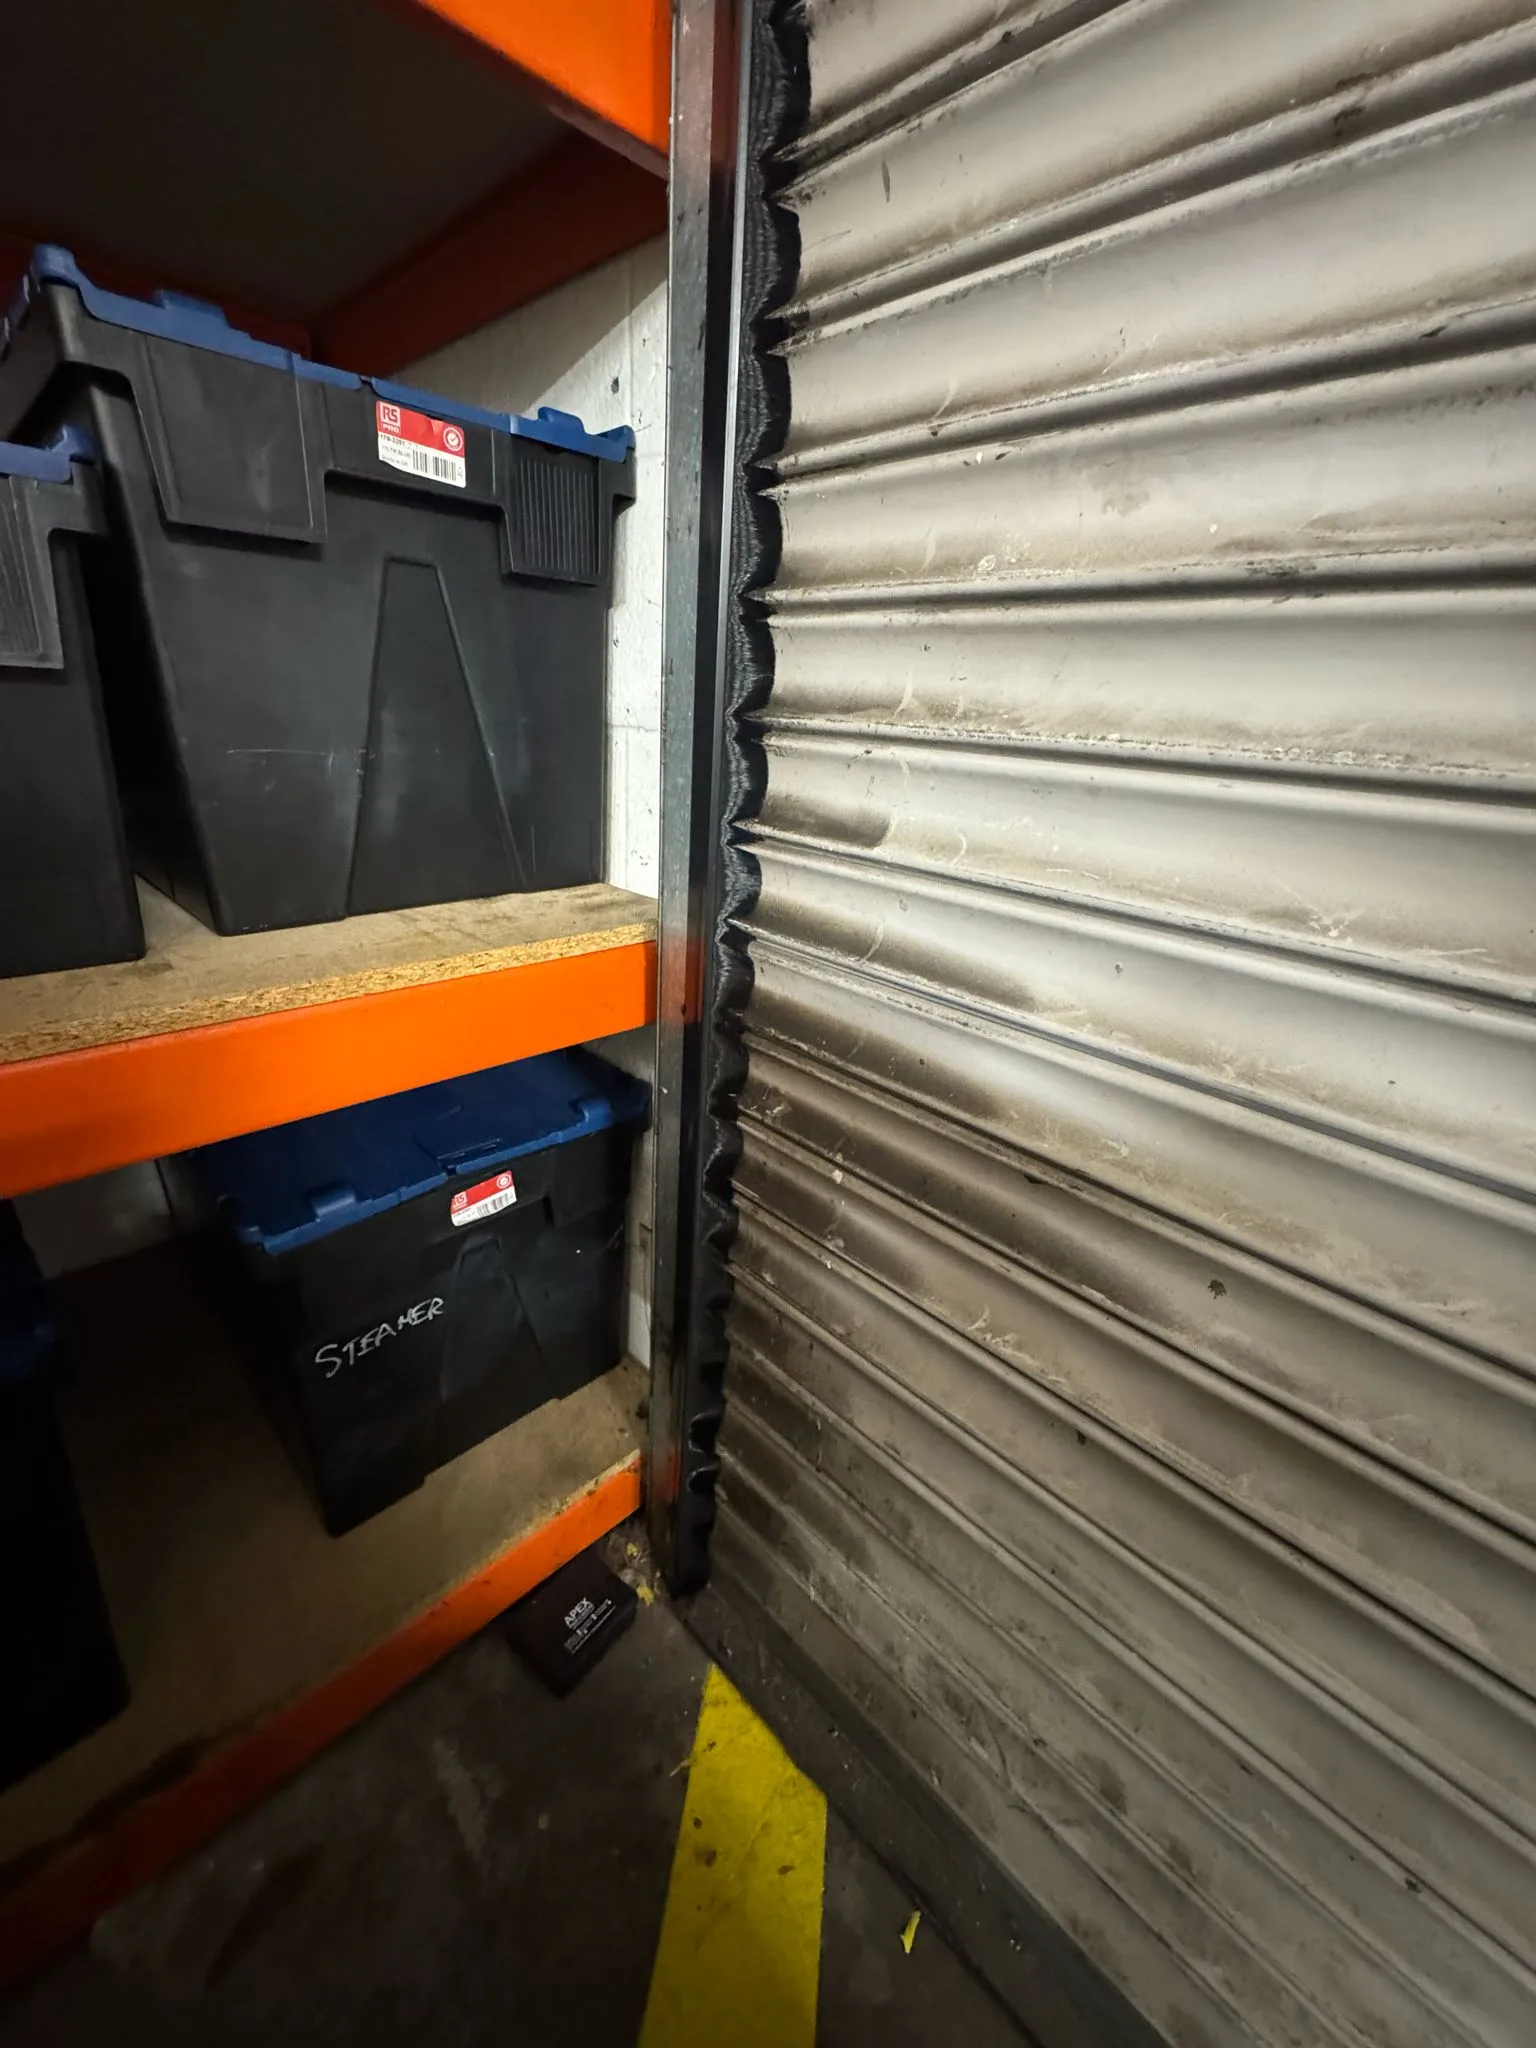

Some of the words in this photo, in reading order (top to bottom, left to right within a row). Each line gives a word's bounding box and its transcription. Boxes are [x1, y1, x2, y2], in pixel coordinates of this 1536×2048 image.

[382, 406, 398, 423] RS
[382, 424, 400, 434] PRO
[314, 1297, 444, 1378] STEAMER
[563, 1597, 592, 1626] APEX
